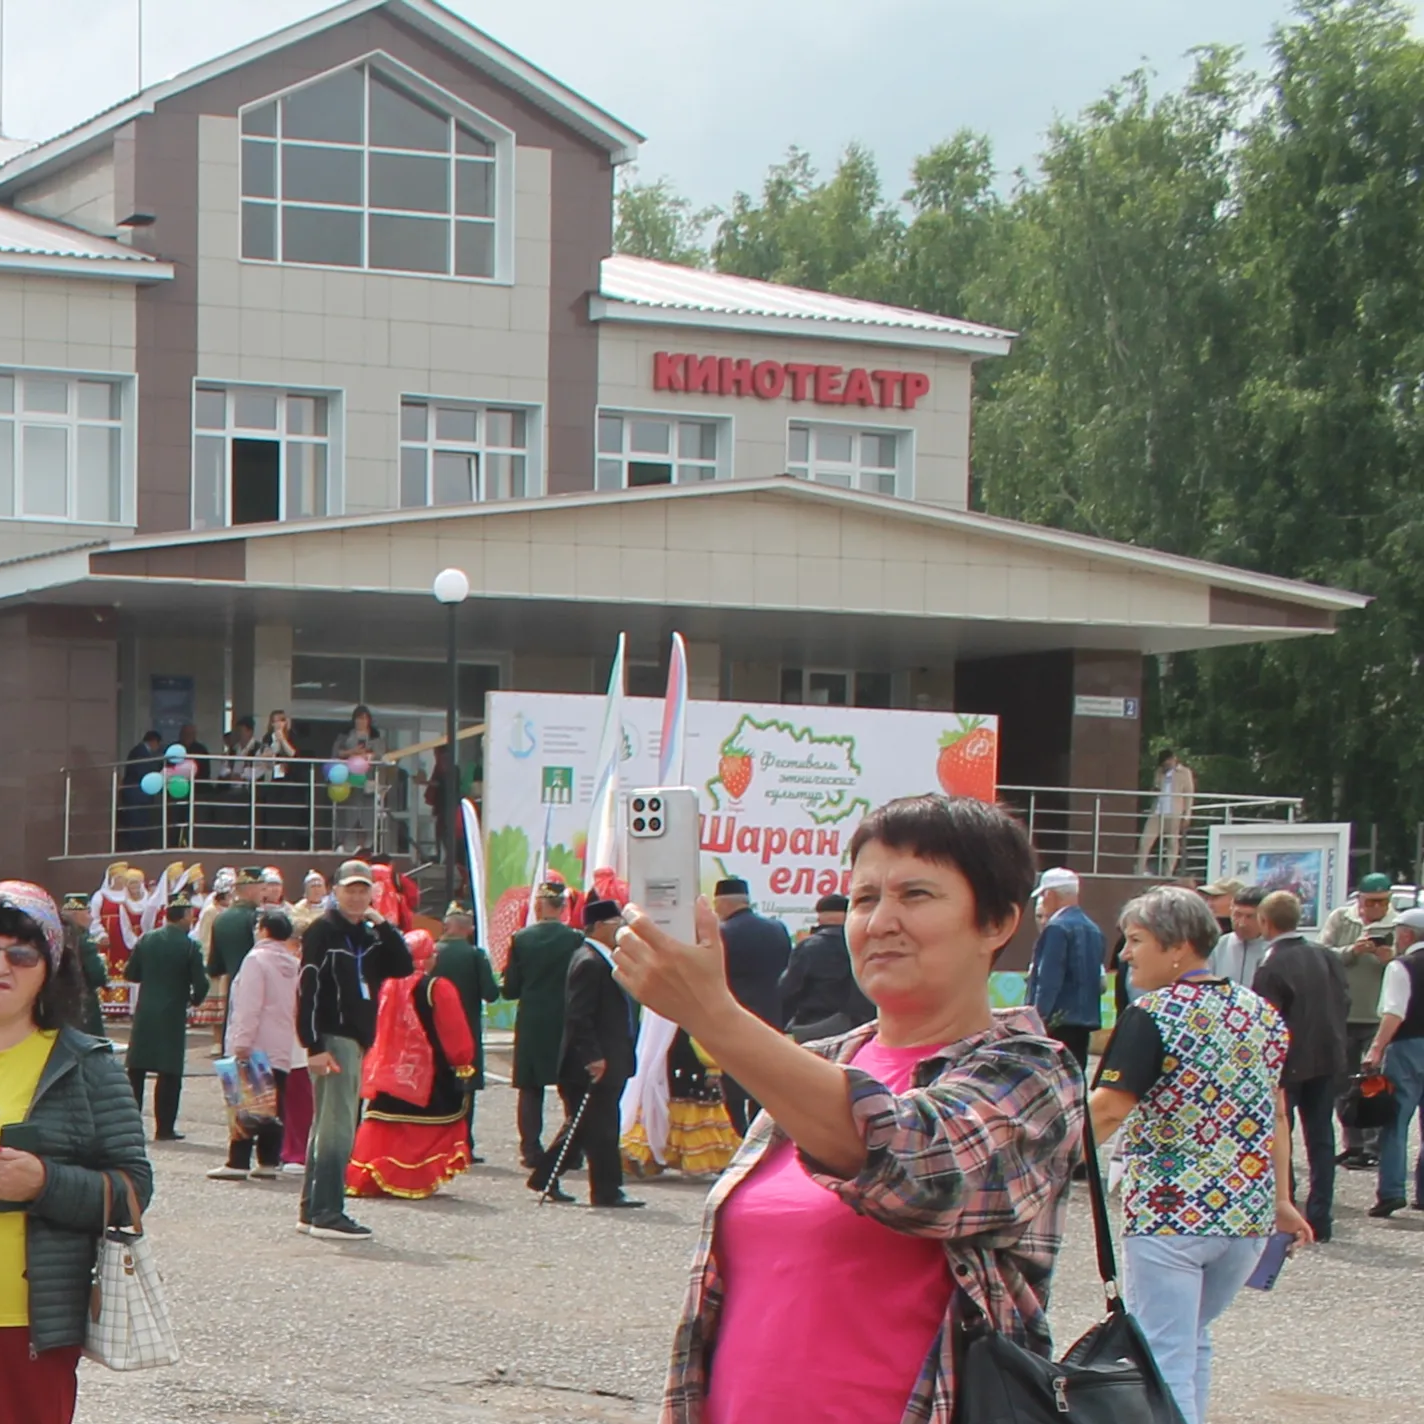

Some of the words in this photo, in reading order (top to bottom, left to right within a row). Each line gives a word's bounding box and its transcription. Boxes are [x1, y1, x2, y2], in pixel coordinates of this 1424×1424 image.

[653, 350, 931, 410] КИНОТЕАТР
[1126, 700, 1135, 715] 2
[760, 751, 839, 773] Фестиваль
[778, 774, 856, 786] этнических
[764, 790, 825, 808] культур
[698, 813, 840, 865] Шаран
